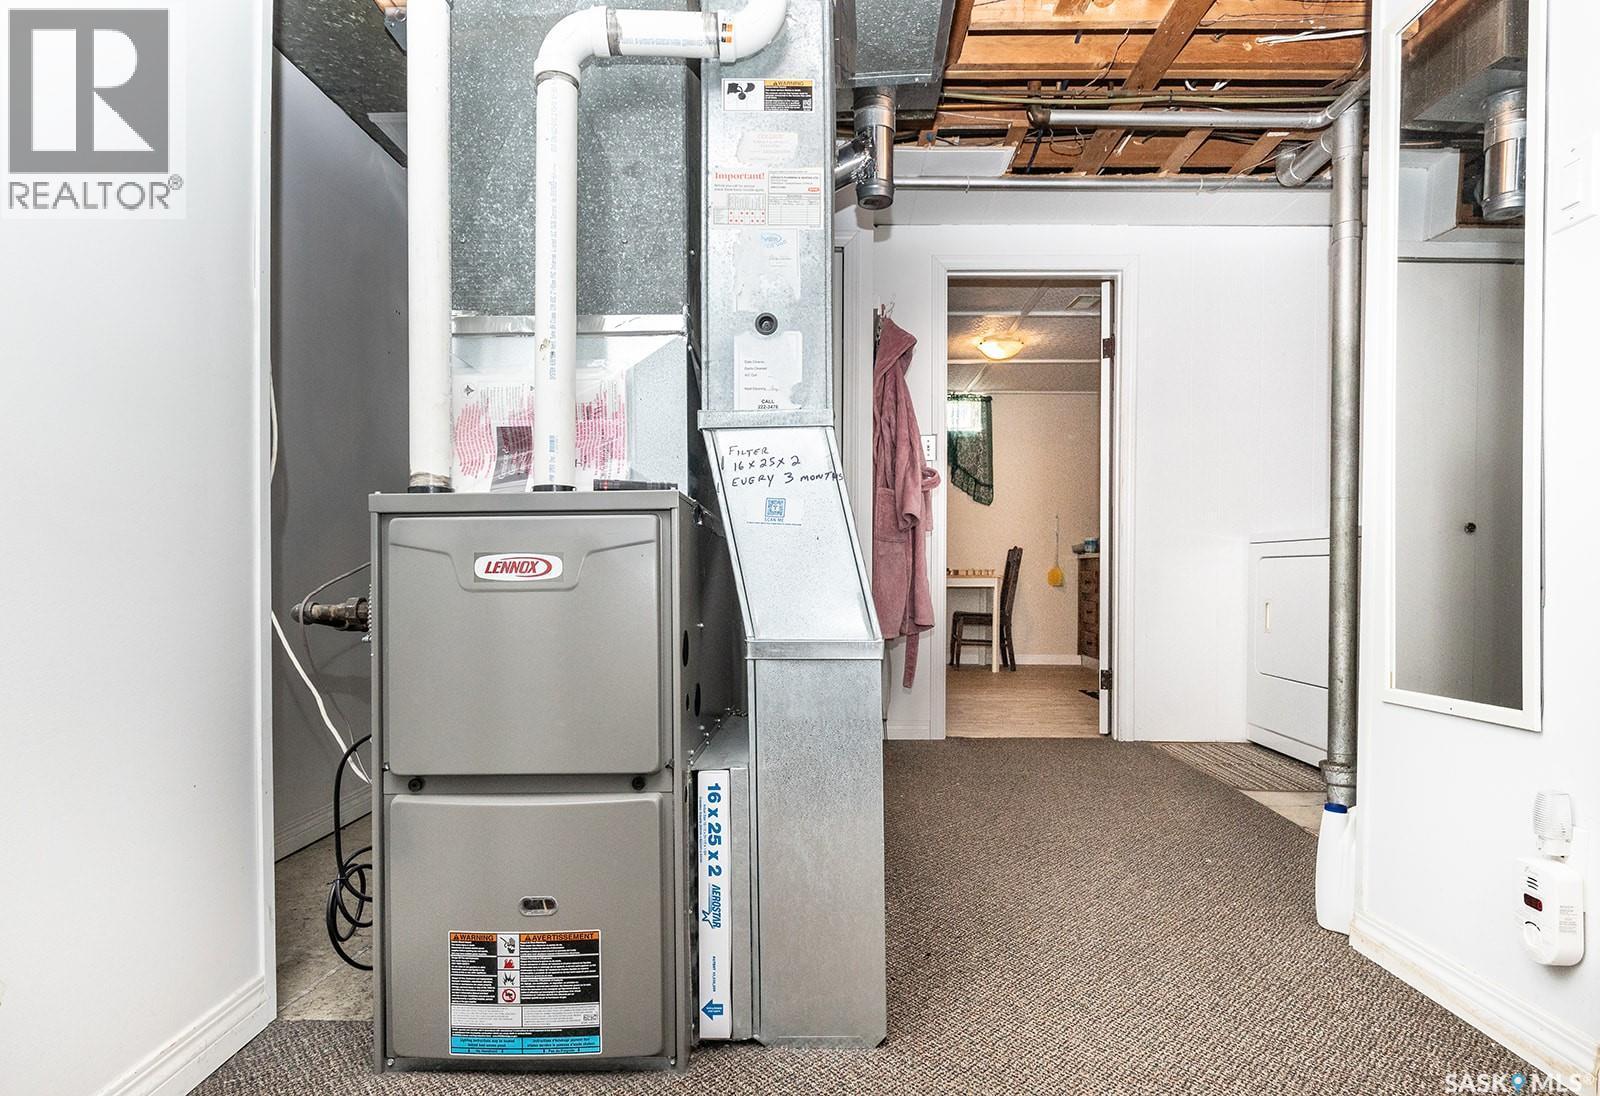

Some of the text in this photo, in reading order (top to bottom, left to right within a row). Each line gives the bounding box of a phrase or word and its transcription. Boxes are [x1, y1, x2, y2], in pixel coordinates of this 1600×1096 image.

[715, 172, 765, 181] Important!
[784, 472, 794, 484] 3
[484, 561, 540, 574] LENNOX
[707, 783, 722, 804] 16
[708, 822, 722, 846] 25
[708, 865, 722, 877] 2
[712, 884, 722, 929] AEROSTAR
[532, 933, 594, 941] AVERTISSEMENT
